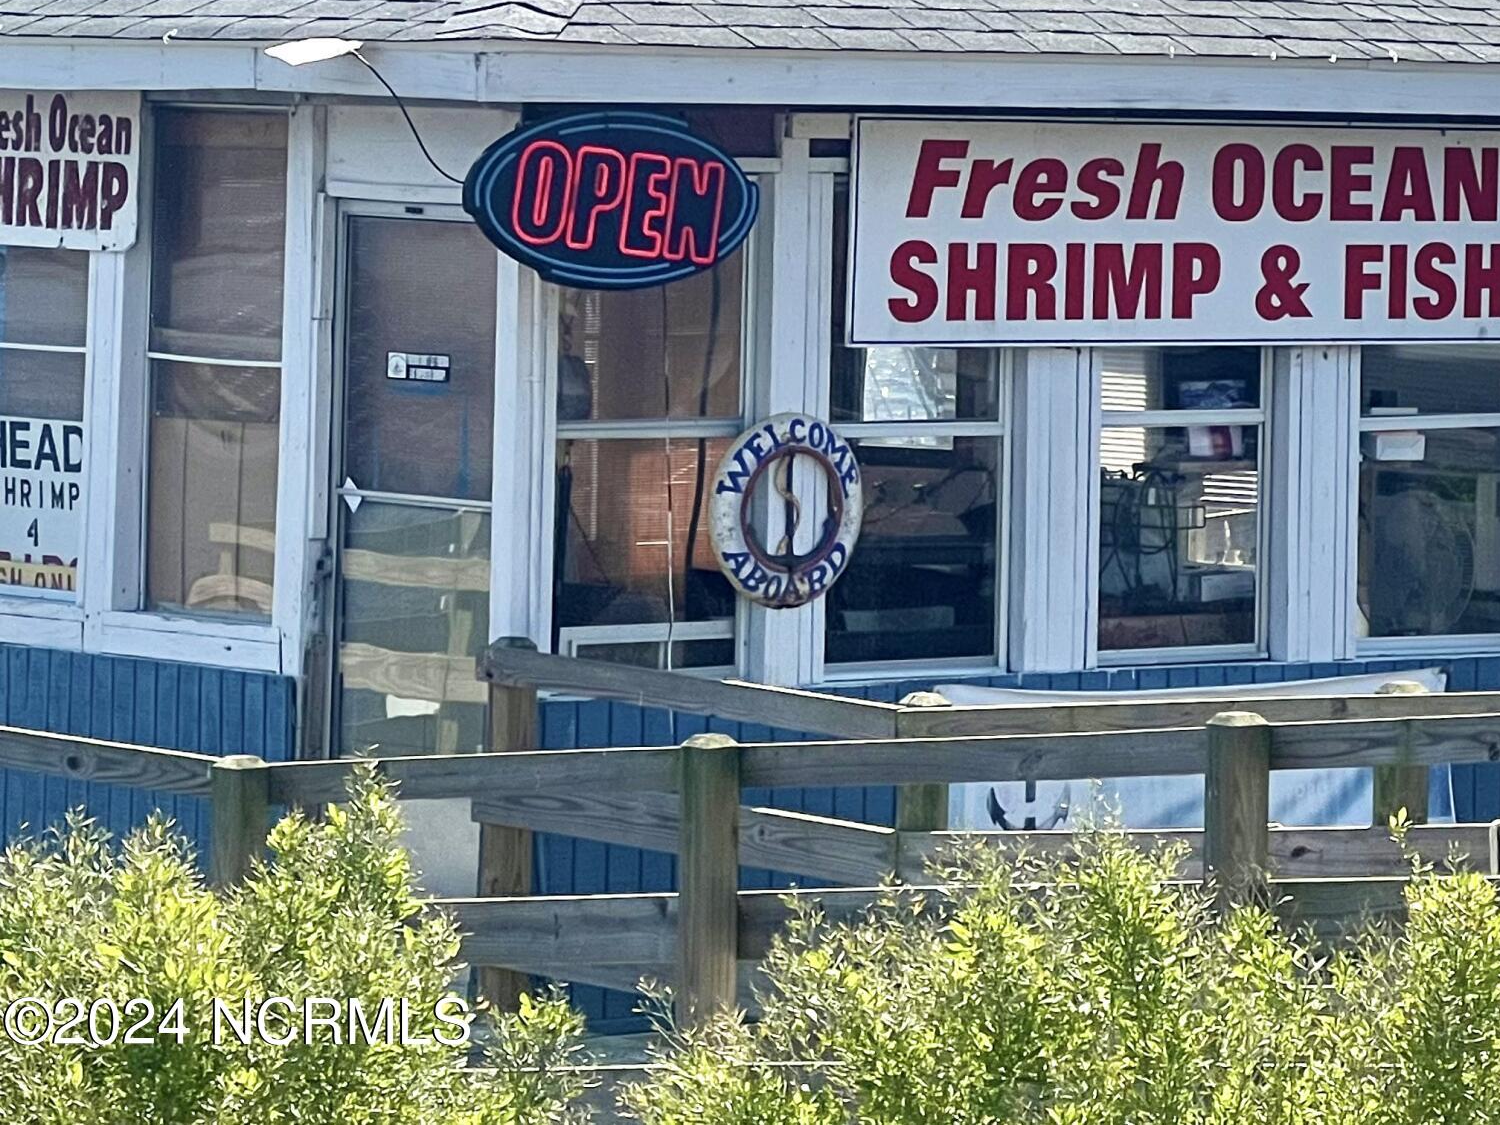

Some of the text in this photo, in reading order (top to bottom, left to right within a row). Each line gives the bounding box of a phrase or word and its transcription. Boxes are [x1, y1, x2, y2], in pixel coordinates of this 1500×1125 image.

[49, 93, 132, 155] Ocean
[511, 139, 726, 265] OPEN
[905, 138, 1499, 222] Fresh OCEAN
[887, 239, 1221, 323] SHRIMP
[1254, 244, 1313, 321] &
[715, 418, 859, 499] WELCOME
[27, 517, 39, 547] 4
[721, 541, 846, 602] ABOARD
